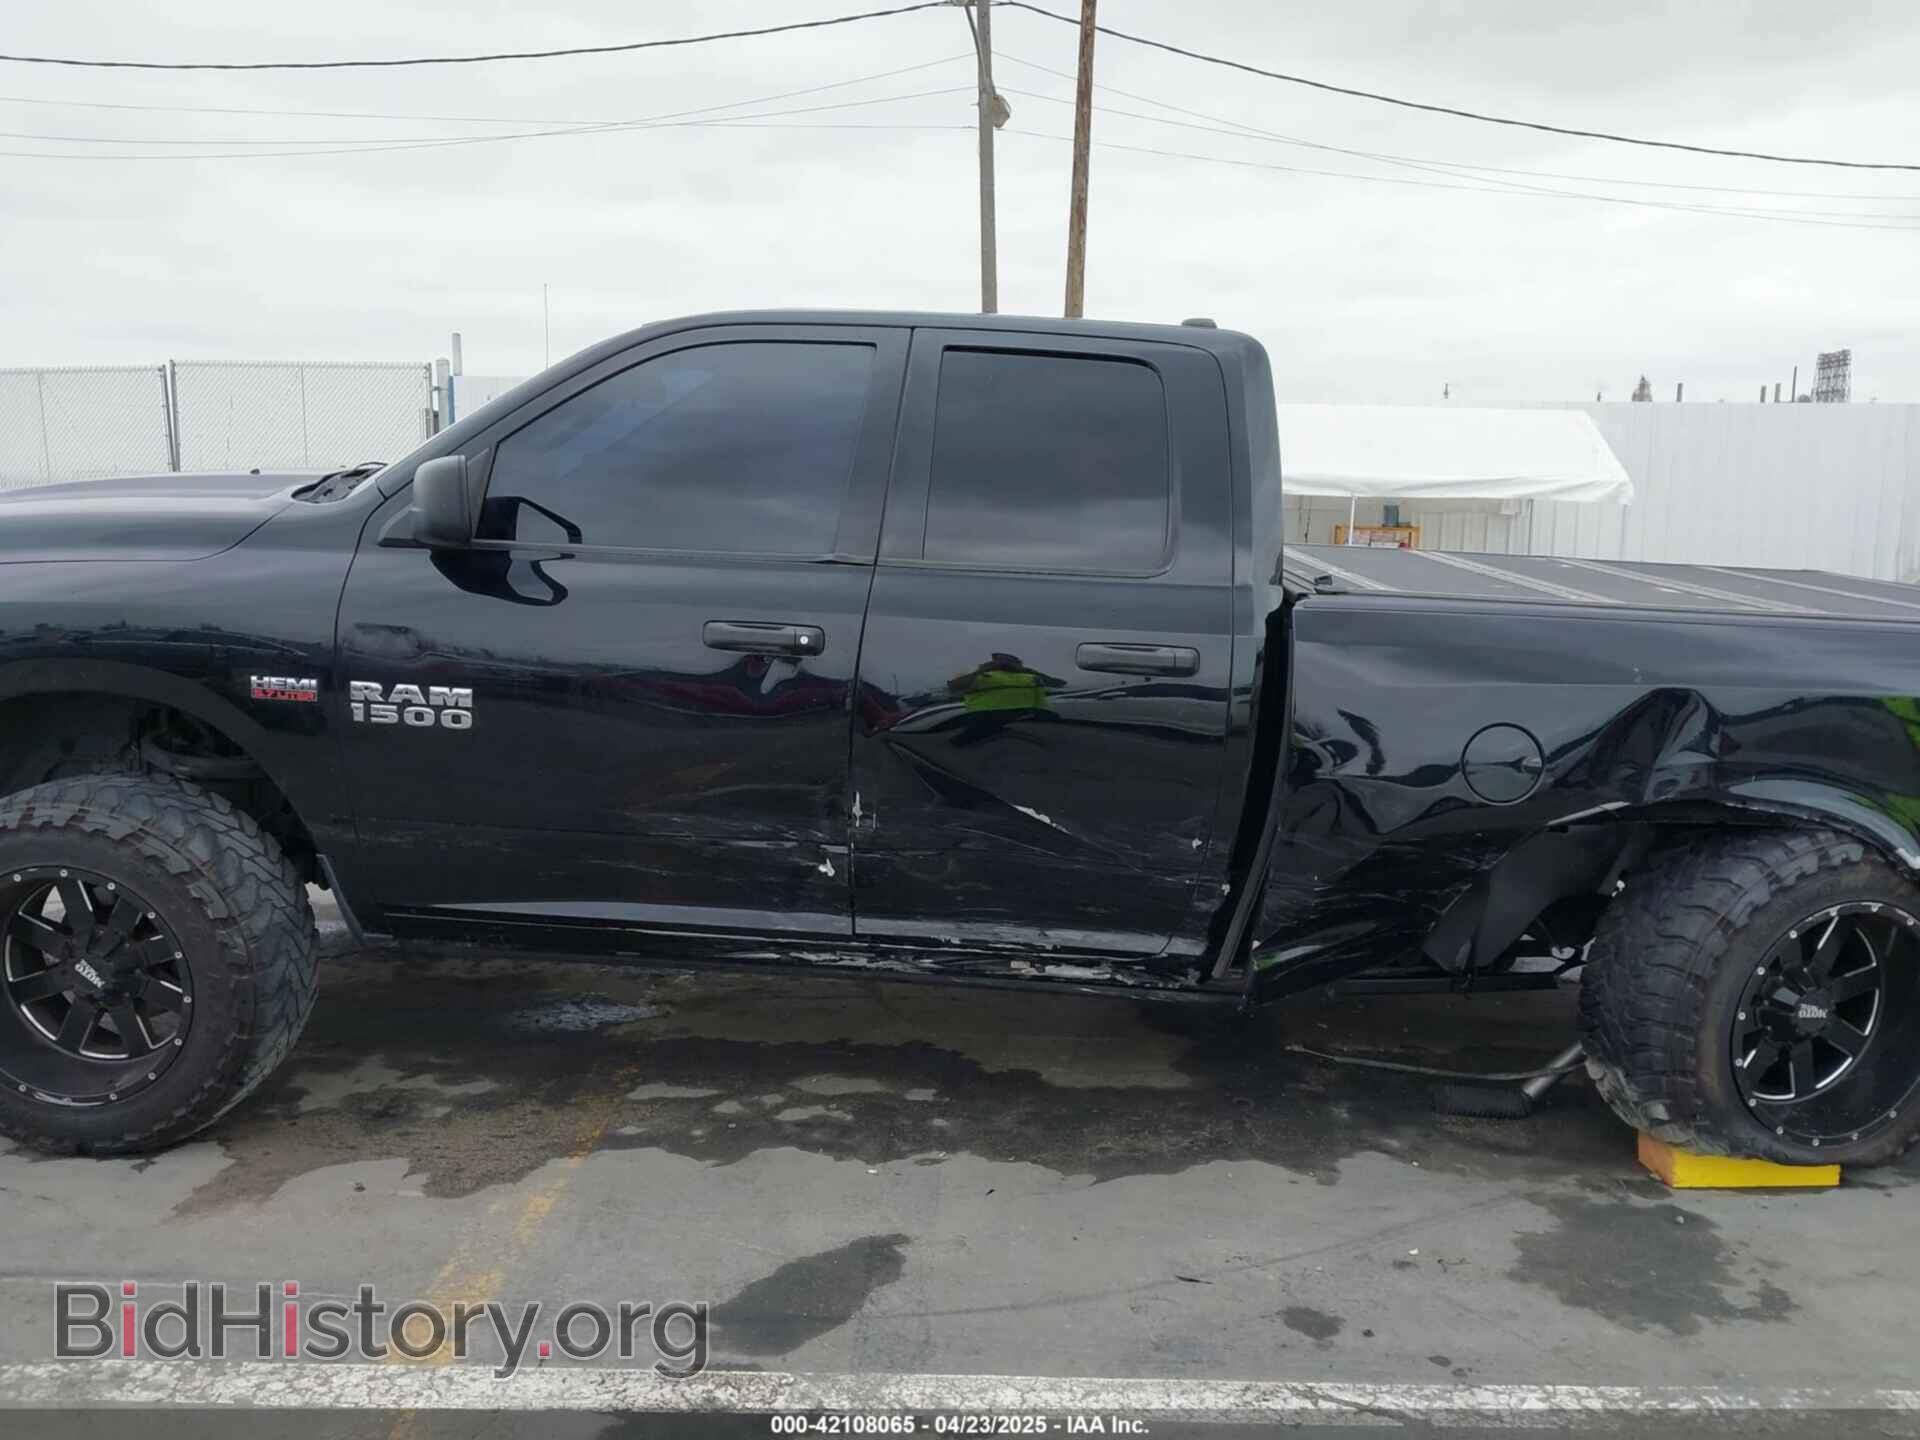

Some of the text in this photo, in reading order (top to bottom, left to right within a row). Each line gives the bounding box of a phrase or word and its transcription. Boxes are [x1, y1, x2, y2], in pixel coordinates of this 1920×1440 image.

[250, 675, 317, 690] HEMI
[349, 680, 473, 708] RAM
[351, 702, 473, 730] 1500
